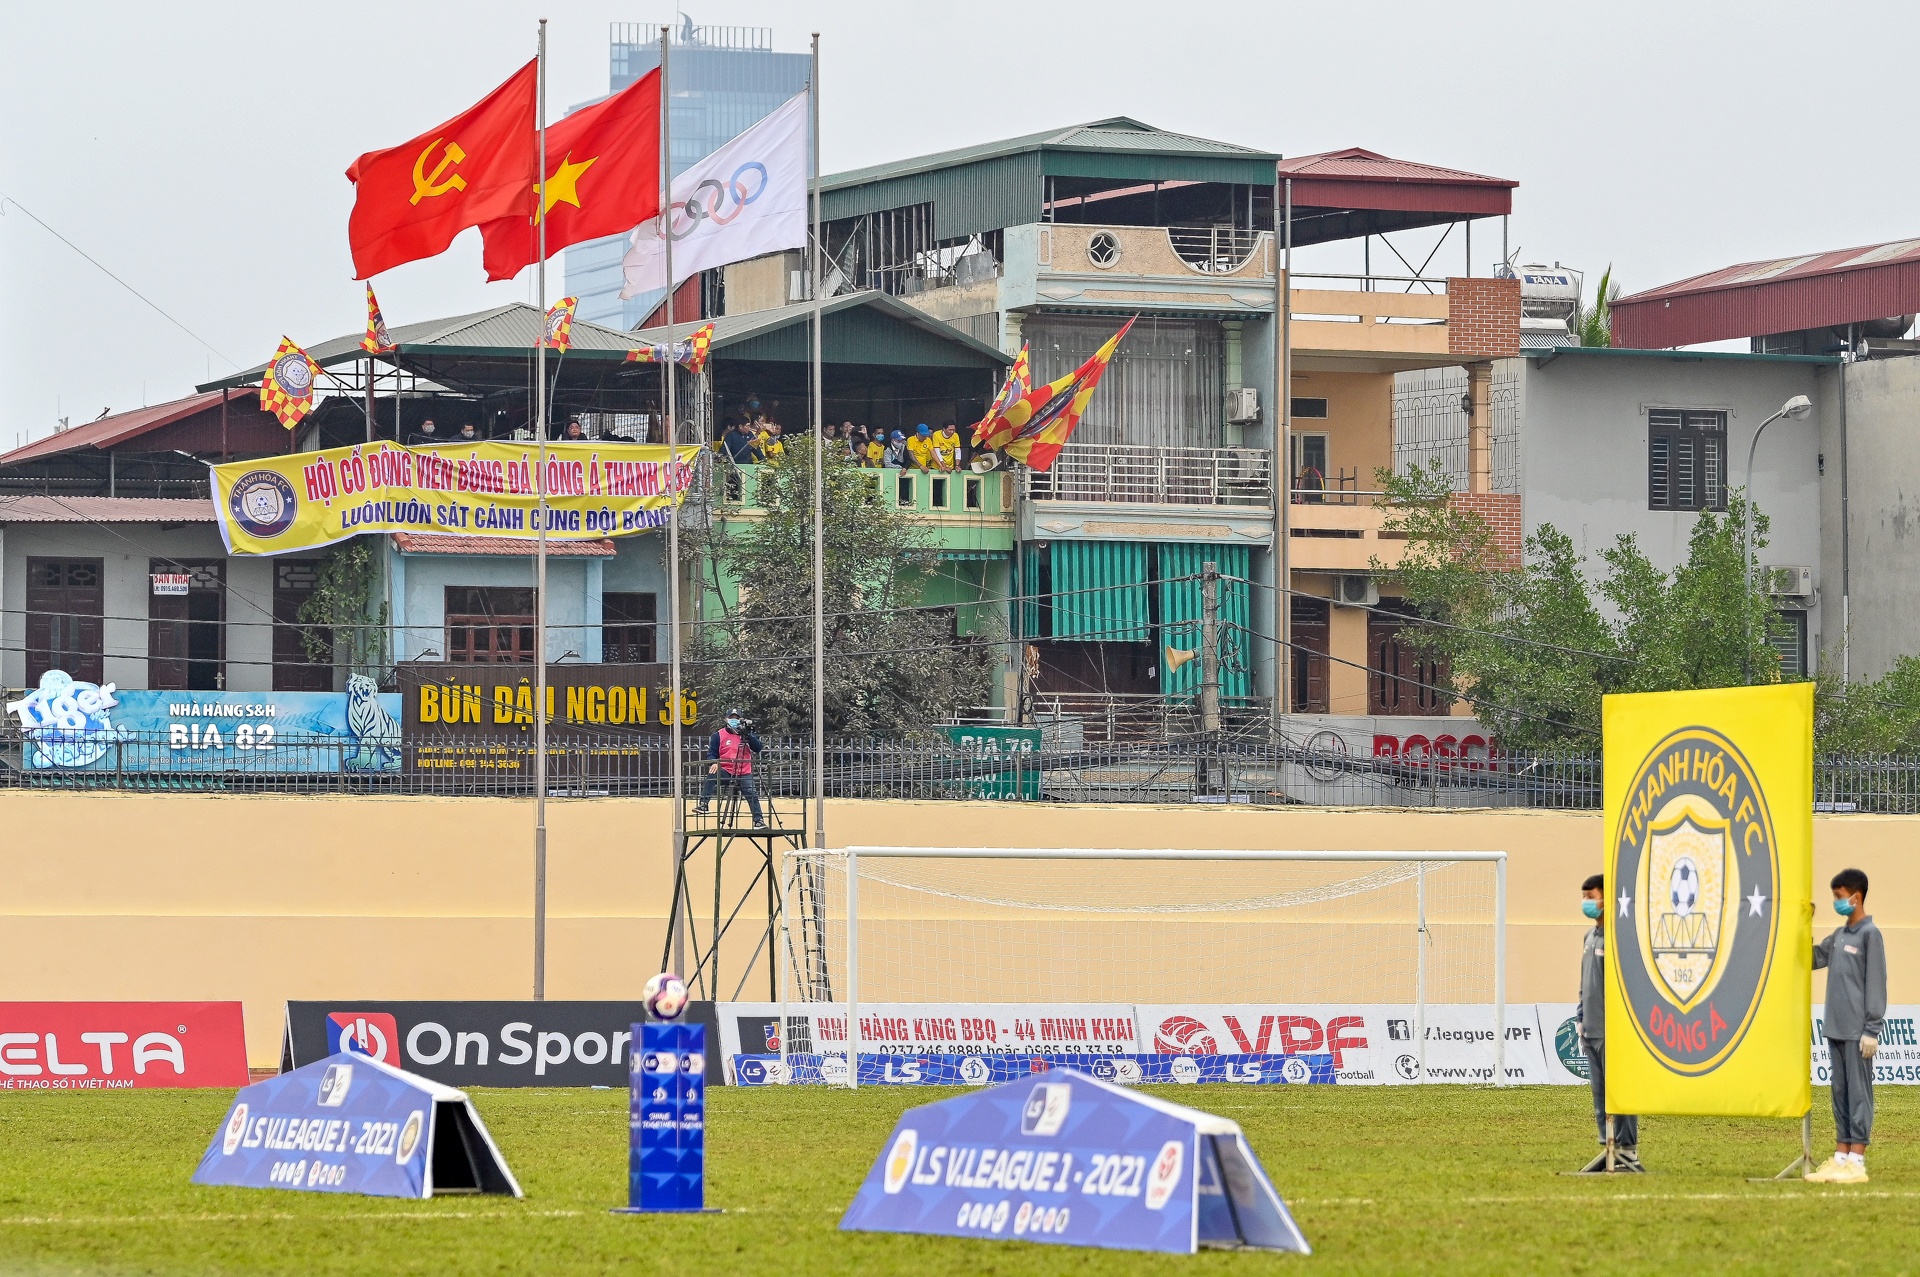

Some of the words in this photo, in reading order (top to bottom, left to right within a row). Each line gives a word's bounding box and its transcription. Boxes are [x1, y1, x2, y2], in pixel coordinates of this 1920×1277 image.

[233, 474, 258, 498] THANH
[277, 480, 289, 492] FC
[304, 456, 338, 507] HỘI
[339, 444, 366, 495] CỔ
[415, 451, 454, 490] VIÊN
[457, 452, 504, 493] BÓNG
[507, 453, 533, 495] ĐÁ
[589, 453, 601, 496] Á
[603, 461, 660, 496] THANH
[436, 501, 470, 528] SÁT
[474, 502, 524, 530] CÁNH
[530, 504, 580, 531] CÙNG
[586, 506, 617, 536] ĐỘI
[169, 700, 202, 717] NHÀ
[203, 700, 244, 717] HÀNG
[245, 703, 276, 717] S&H
[420, 676, 481, 724] BÚN
[566, 686, 646, 725] NGON
[169, 724, 225, 750] BIA
[235, 724, 276, 750] 82
[1621, 749, 1690, 848] THANH
[1692, 751, 1738, 811] HÓA
[1735, 800, 1764, 857] FC
[1673, 968, 1694, 984] 1962
[817, 1013, 847, 1041] NH
[859, 1013, 909, 1041] HÀNG
[913, 1018, 956, 1041] KING
[960, 1018, 998, 1043] BBQ
[1015, 1018, 1036, 1041] 44
[1040, 1018, 1087, 1041] MINH
[1091, 1018, 1133, 1041] KHAI
[1222, 1016, 1369, 1068] VPF
[1649, 1005, 1708, 1054] ĐÔNG
[1709, 1002, 1729, 1043] Á
[405, 1022, 489, 1066] On
[498, 1021, 632, 1076] Spor
[17, 1078, 50, 1090] THAO
[52, 1076, 69, 1089] SỐ
[71, 1078, 76, 1089] 1
[106, 1078, 134, 1089] NAM
[746, 1067, 761, 1076] LS
[884, 1062, 921, 1083] LS
[1226, 1062, 1262, 1083] LS
[1335, 1069, 1375, 1080] Football
[241, 1117, 267, 1149] LS
[264, 1117, 340, 1152] V.LEAGUE
[336, 1121, 351, 1153] 1
[354, 1122, 400, 1155] 2021
[911, 1145, 947, 1187] LS
[945, 1147, 1063, 1192] V.LEAGUE
[1054, 1152, 1072, 1193] 1
[1081, 1154, 1147, 1197] 2021
